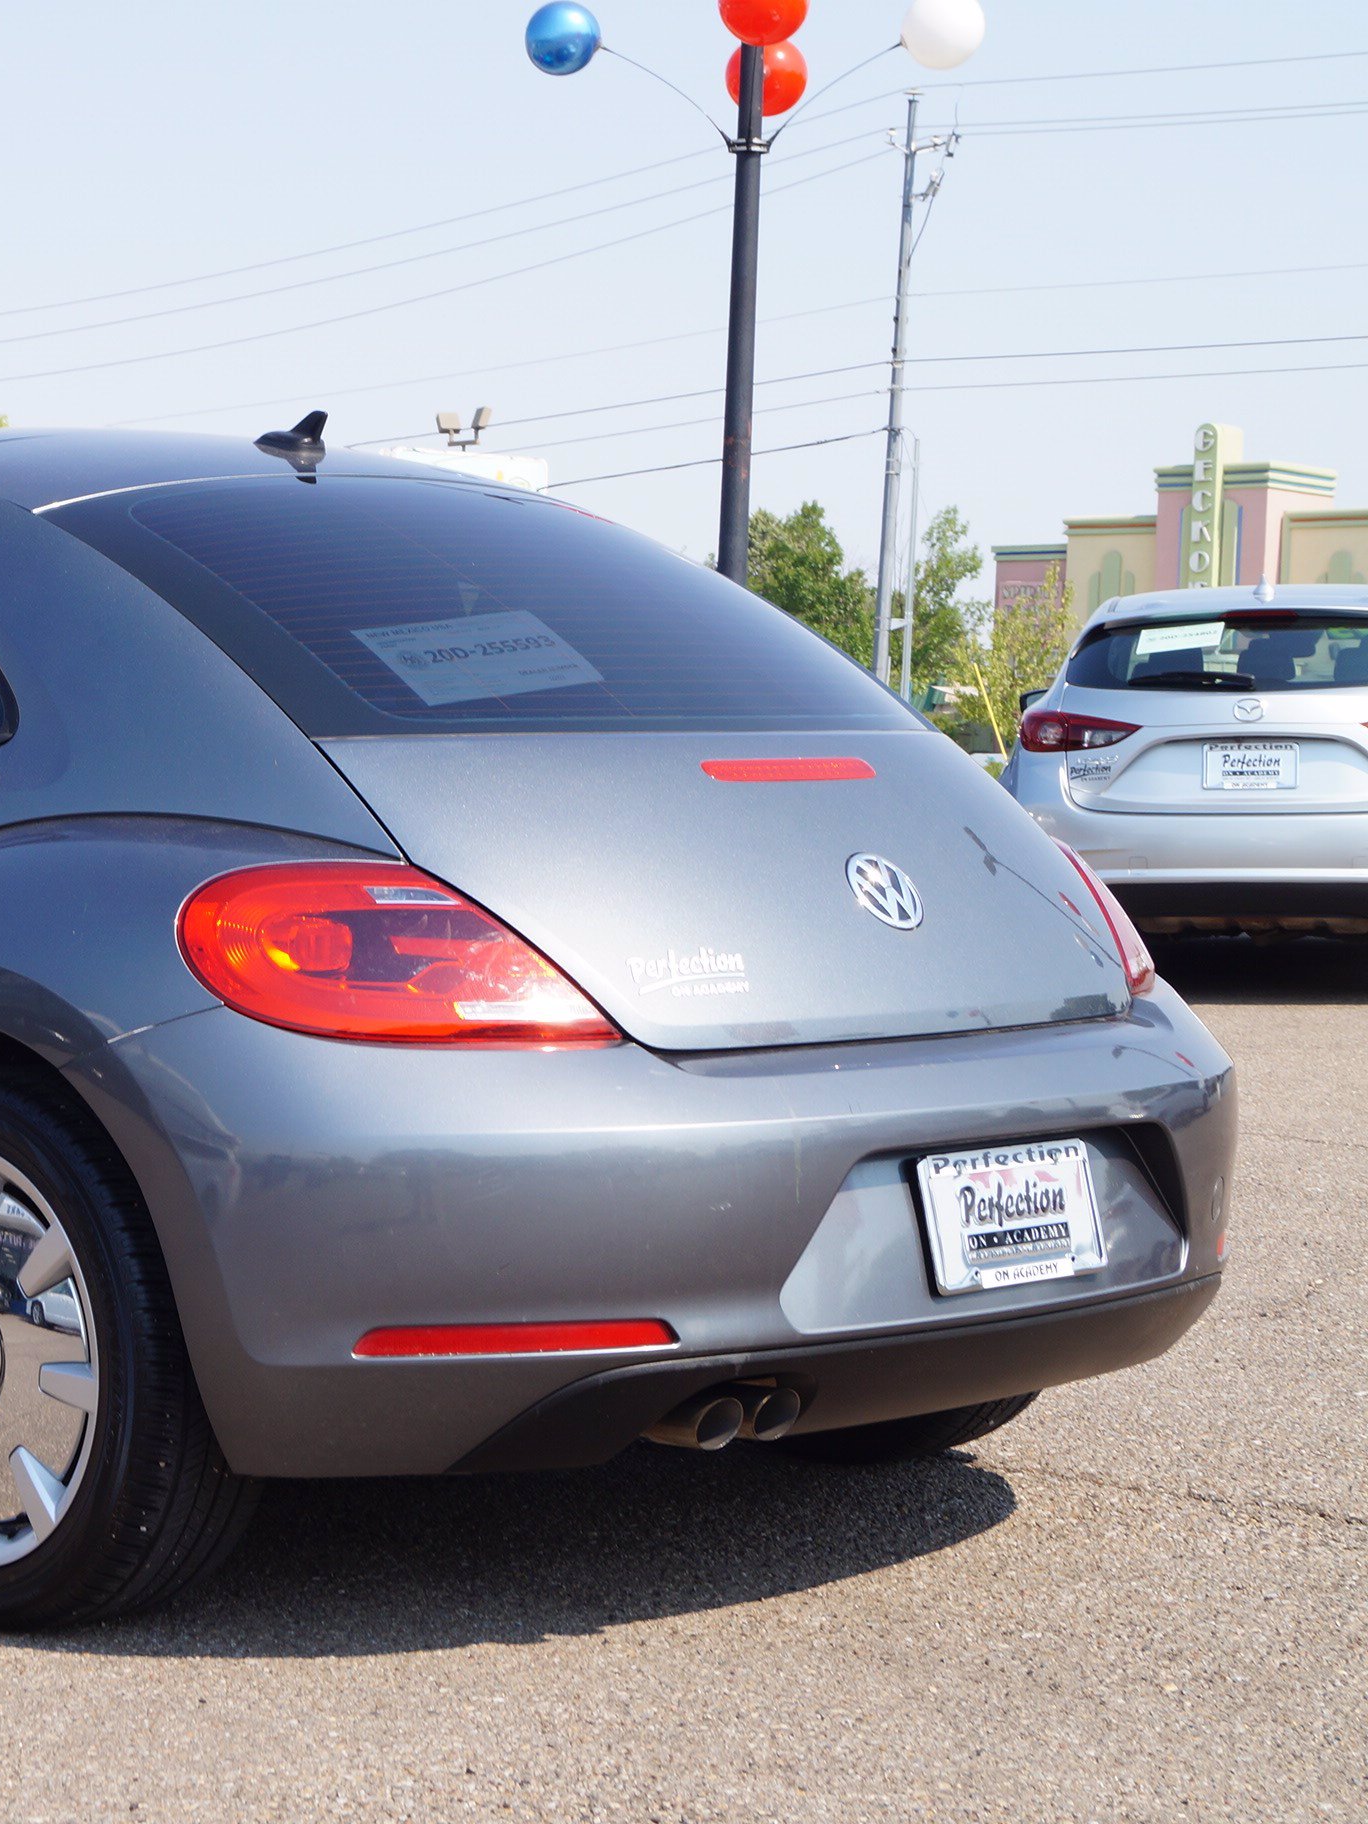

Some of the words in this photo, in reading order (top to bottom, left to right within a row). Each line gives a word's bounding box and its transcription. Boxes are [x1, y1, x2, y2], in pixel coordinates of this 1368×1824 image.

[423, 635, 556, 664] 20D-255593
[1209, 743, 1294, 751] Perfection
[1070, 763, 1111, 777] Perfection
[1222, 753, 1281, 770] Perfection
[625, 946, 745, 984] Perfection
[932, 1144, 1080, 1175] Perfection
[958, 1179, 1065, 1228] Perfection
[969, 1234, 987, 1250] ON
[1004, 1222, 1068, 1245] ACADEMY
[994, 1269, 1010, 1282] ON
[1013, 1262, 1059, 1280] ACADEMY
